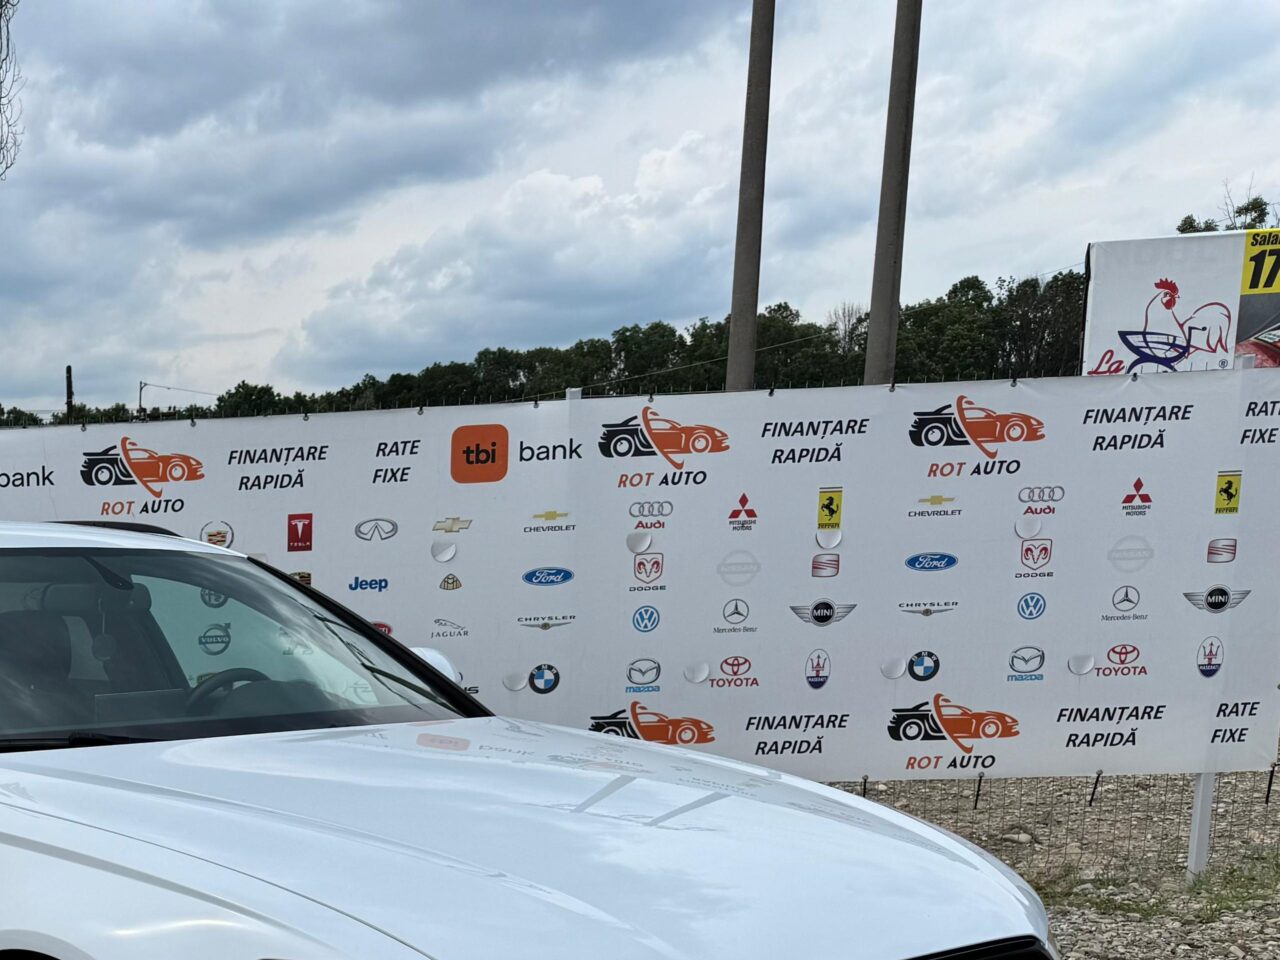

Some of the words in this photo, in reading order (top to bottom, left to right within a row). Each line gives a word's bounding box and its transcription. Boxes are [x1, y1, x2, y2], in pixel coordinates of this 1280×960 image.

[1250, 232, 1280, 247] Sala
[1249, 249, 1280, 289] 17
[1087, 349, 1125, 375] La
[1083, 405, 1194, 426] FINANȚARE
[1245, 401, 1280, 417] RAT
[761, 419, 869, 439] FINANȚARE
[1240, 428, 1279, 444] FIXE
[375, 439, 421, 457] RATE
[1092, 429, 1166, 451] RAPIDĂ
[227, 445, 329, 467] FINANȚARE
[463, 441, 497, 464] tbi
[519, 438, 582, 461] bank
[771, 443, 842, 464] RAPIDĂ
[372, 467, 411, 484] FIXE
[928, 462, 966, 478] ROT
[970, 460, 1021, 476] AUTO
[238, 469, 304, 491] RAPIDĂ
[618, 472, 654, 488] ROT
[659, 470, 707, 486] AUTO
[101, 500, 135, 516] ROT
[139, 499, 185, 514] AUTO
[908, 509, 962, 517] CHEVROLET
[1023, 505, 1056, 515] Audi
[634, 520, 665, 529] Audi
[915, 555, 948, 568] Ford
[532, 570, 563, 582] Ford
[1014, 571, 1054, 579] DODGE
[348, 576, 388, 592] Jeep
[1207, 595, 1228, 603] MINI
[431, 630, 469, 639] JAGUAR
[1095, 666, 1148, 677] TOYOTA
[709, 678, 759, 687] TOYOTA
[1057, 705, 1166, 725] FINANȚARE
[1216, 702, 1260, 717] RATE
[746, 714, 849, 732] FINANȚARE
[1065, 728, 1139, 748] RAPIDĂ
[1210, 728, 1248, 743] FIXE
[755, 736, 824, 755] RAPIDĂ
[905, 756, 943, 769] ROT
[947, 755, 996, 769] AUTO
